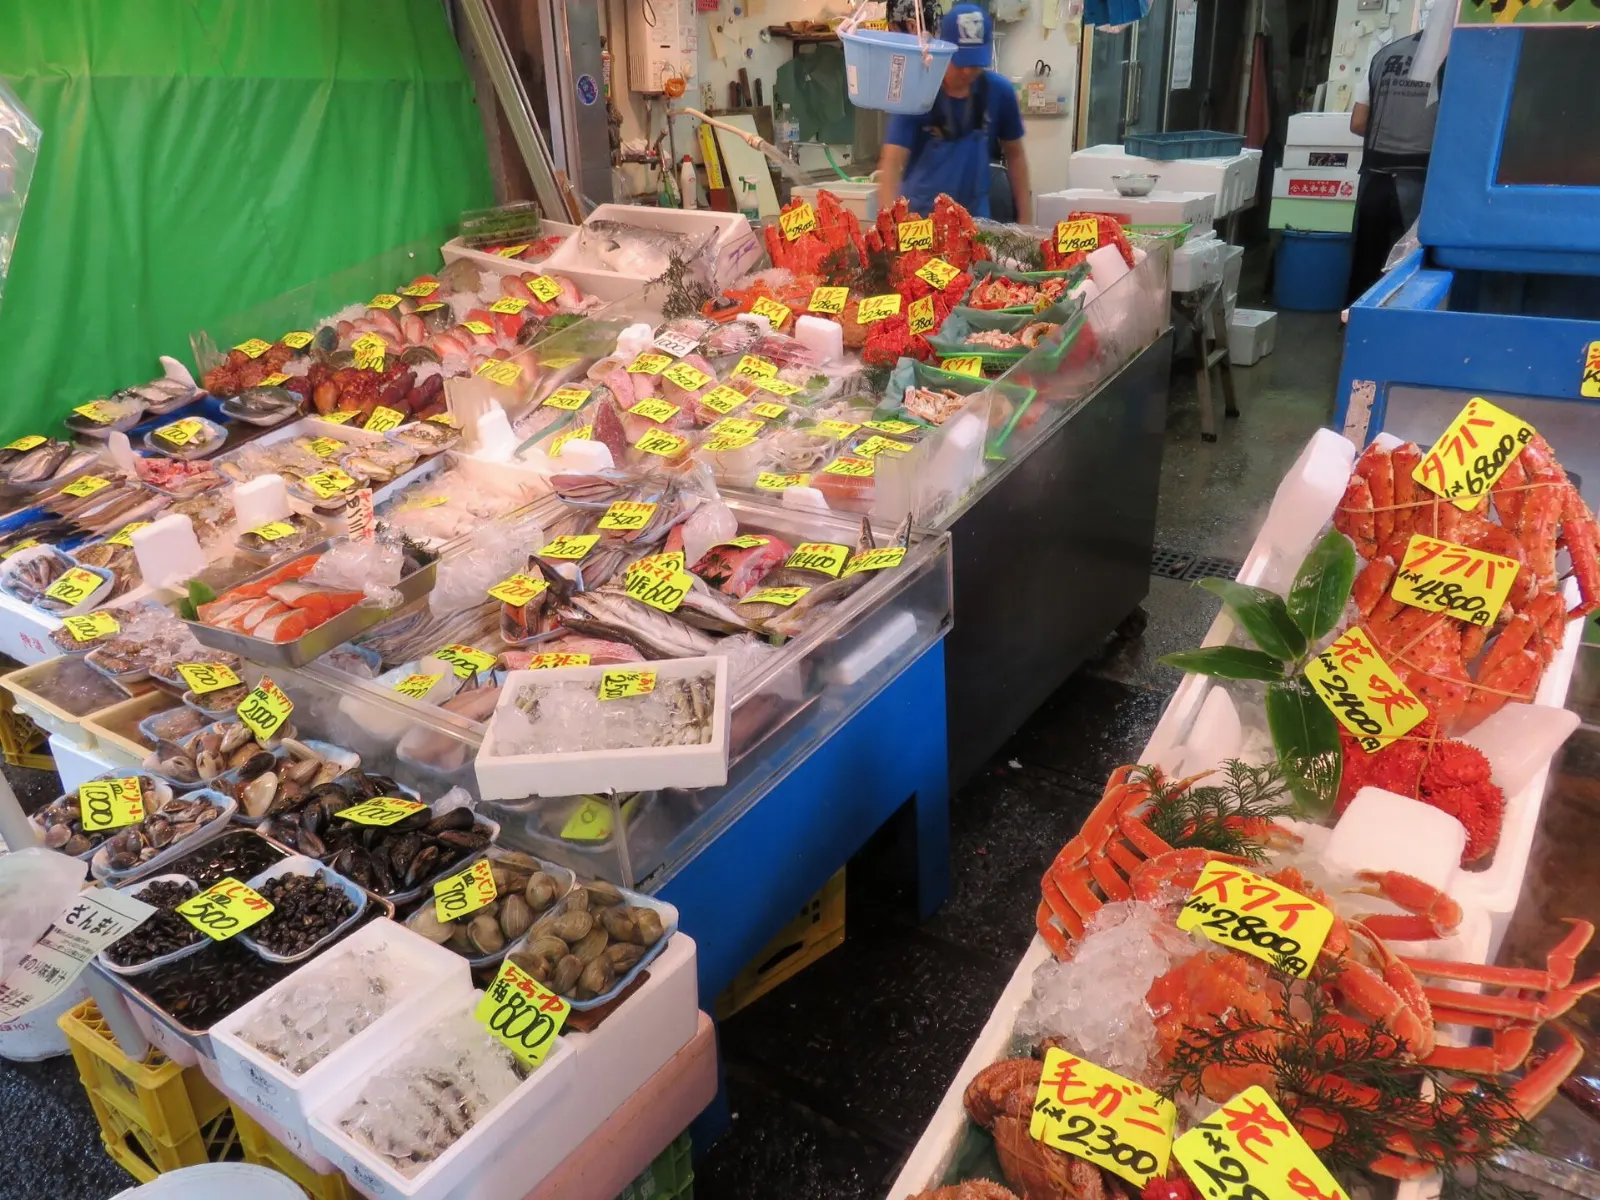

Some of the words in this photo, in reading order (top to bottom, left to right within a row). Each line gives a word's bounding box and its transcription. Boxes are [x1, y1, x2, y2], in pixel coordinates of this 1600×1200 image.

[782, 207, 810, 226] タラバ
[900, 223, 931, 240] タラバ
[1060, 220, 1096, 236] タラバ
[1420, 401, 1496, 492] タラバ
[1404, 541, 1515, 591] タラバ
[640, 578, 685, 606] 600
[1331, 634, 1419, 728] 花咲
[182, 902, 240, 931] 500
[434, 882, 469, 912] 700
[1191, 870, 1317, 932] ズワイ
[489, 991, 556, 1050] 800
[1041, 1057, 1167, 1137] 毛ガニ
